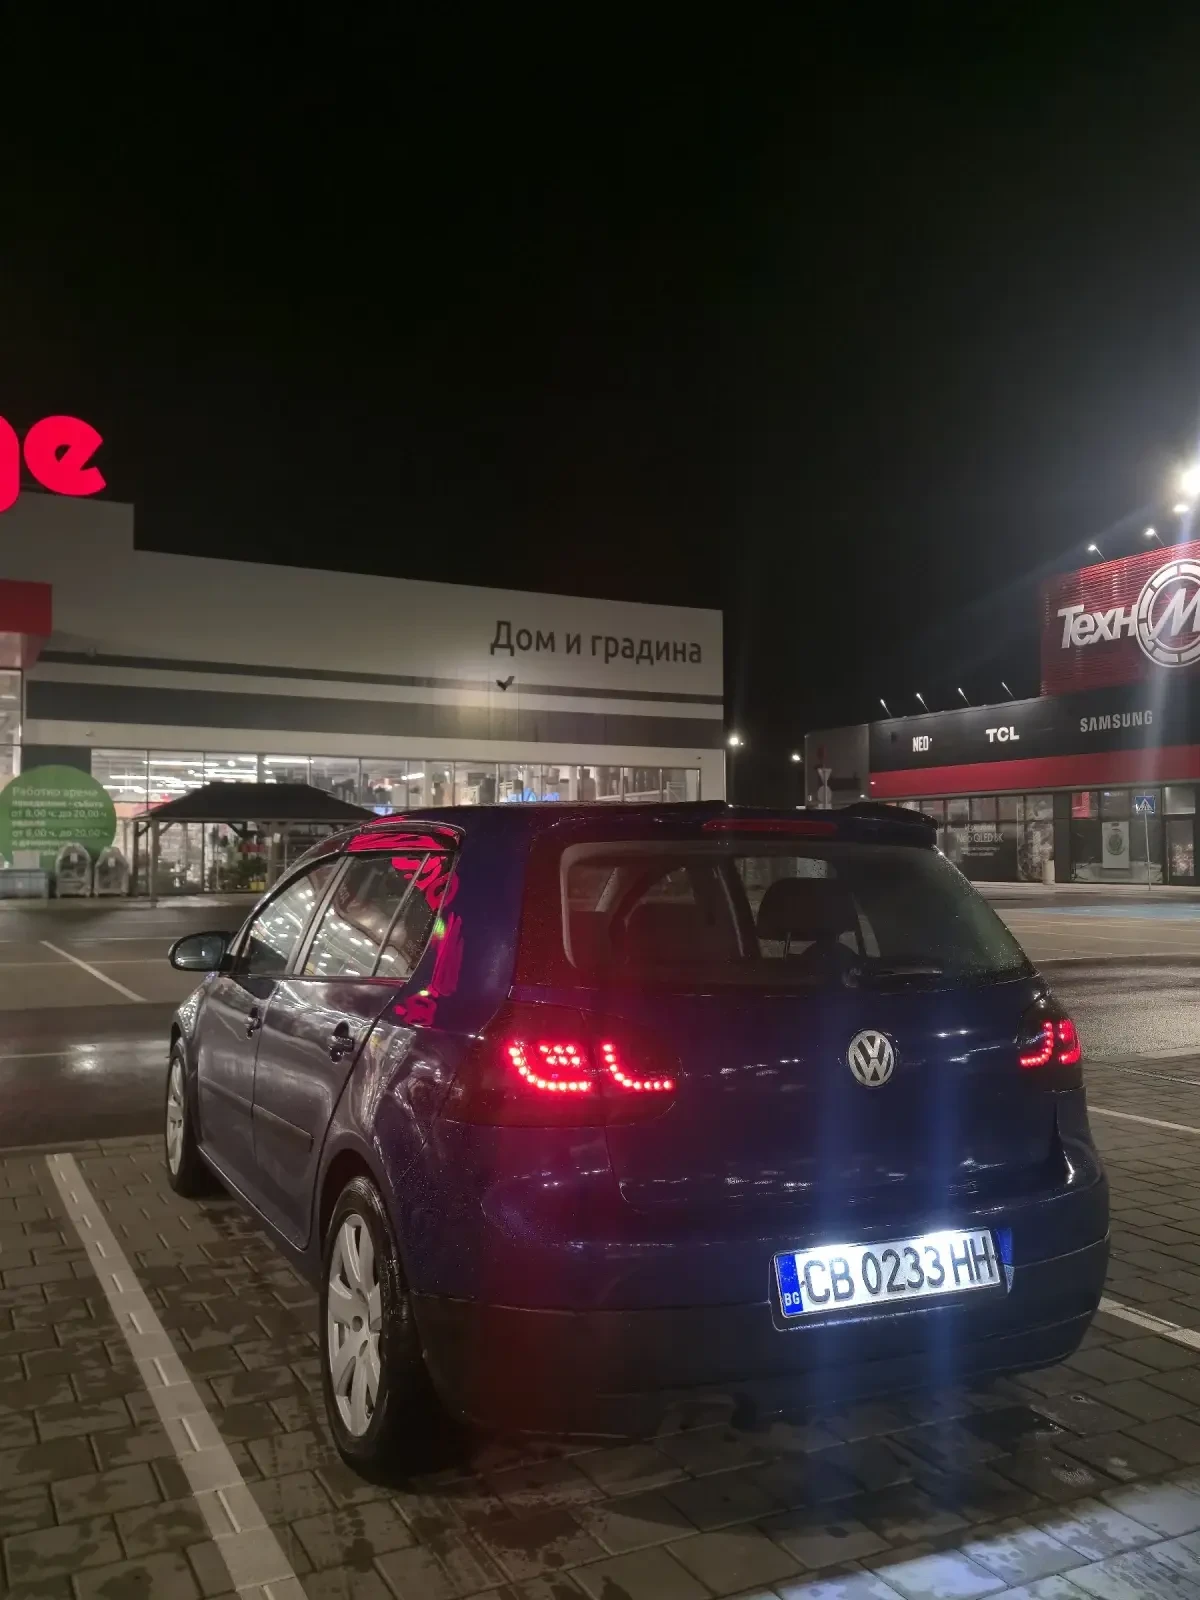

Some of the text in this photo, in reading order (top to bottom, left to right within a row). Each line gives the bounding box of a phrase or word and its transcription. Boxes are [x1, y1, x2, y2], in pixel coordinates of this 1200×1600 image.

[490, 620, 702, 666] Дом и градина
[1079, 710, 1153, 733] SAMSUNG
[986, 726, 1020, 743] TCL
[803, 1236, 994, 1304] CB 0233 HH
[785, 1292, 801, 1306] BG
